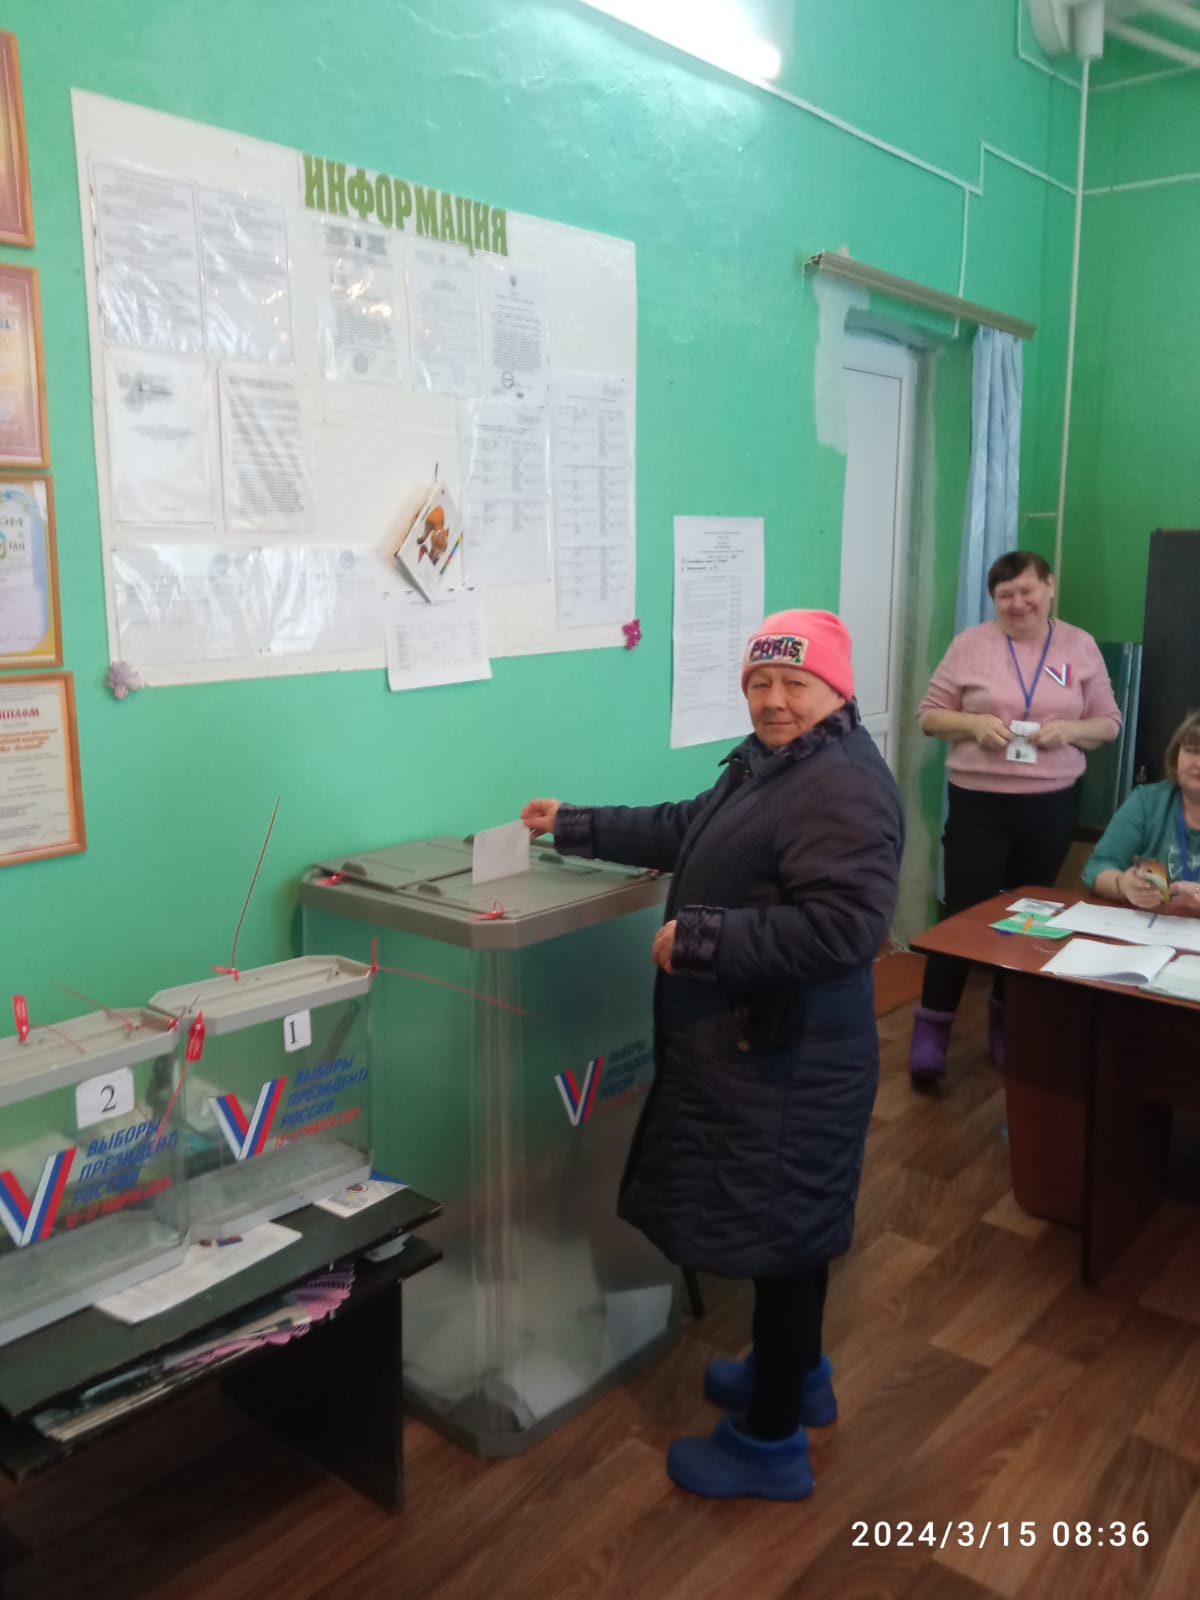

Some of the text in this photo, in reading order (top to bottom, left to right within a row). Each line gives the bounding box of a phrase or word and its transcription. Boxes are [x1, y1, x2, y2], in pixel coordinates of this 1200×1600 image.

[303, 152, 508, 258] ИНФОРМАЦИЯ
[749, 637, 802, 661] PARIS
[289, 1020, 297, 1044] 1
[100, 1085, 117, 1113] 2
[86, 1120, 162, 1158] ВЫБОРЫ
